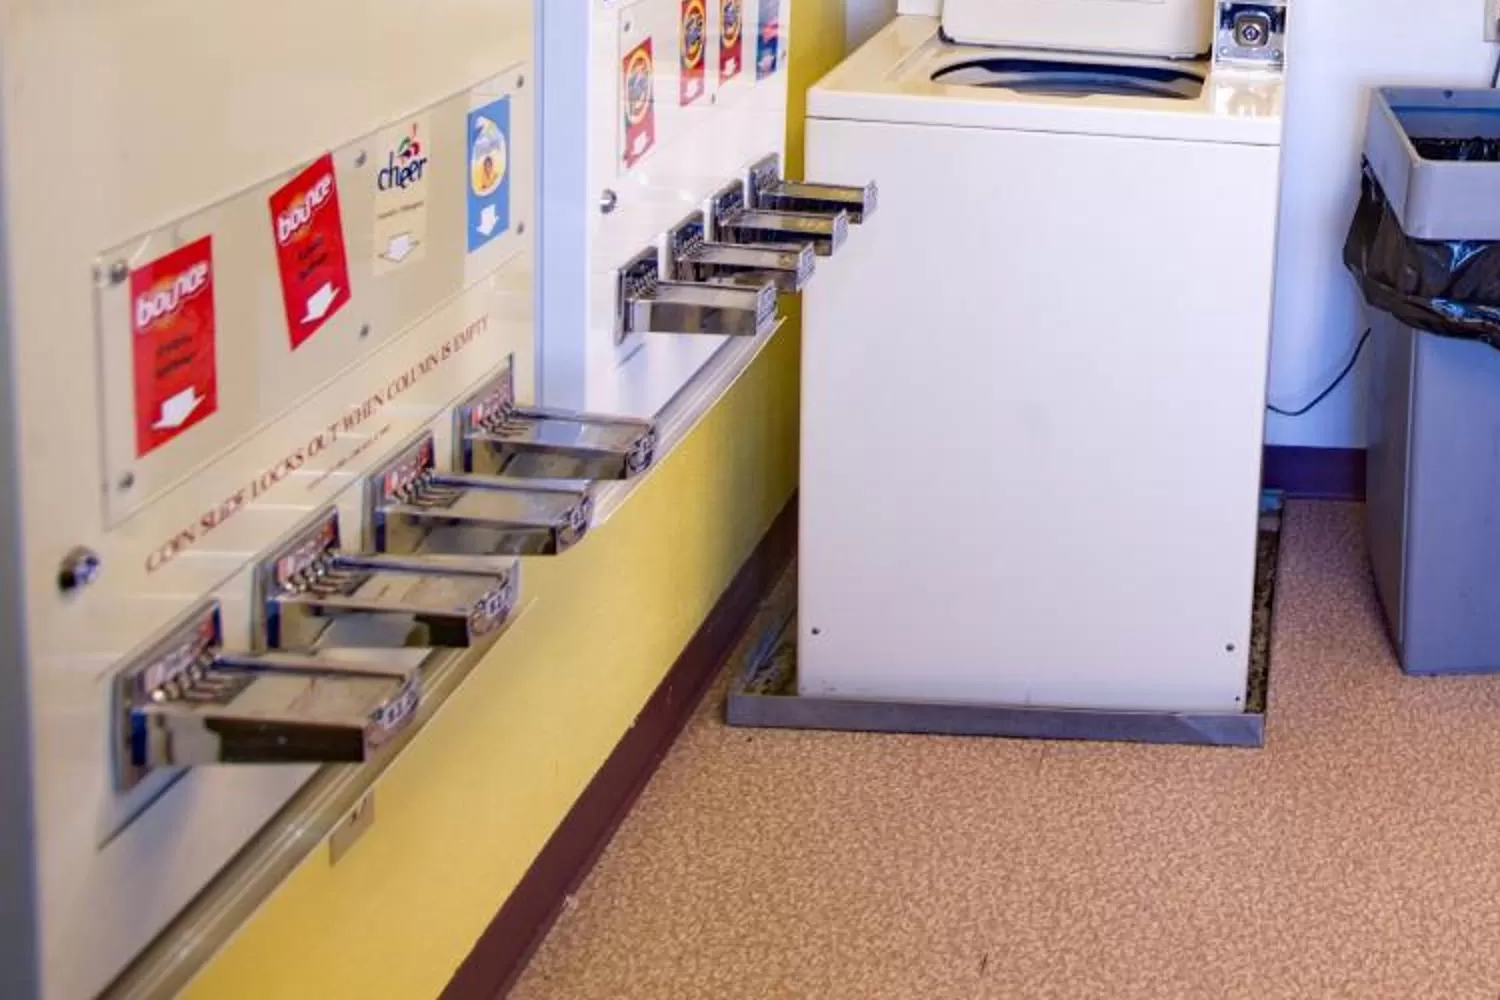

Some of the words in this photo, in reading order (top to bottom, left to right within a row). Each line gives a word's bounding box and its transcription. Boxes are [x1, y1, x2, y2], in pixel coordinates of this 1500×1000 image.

[377, 151, 427, 191] cheer
[278, 174, 332, 243] bounce
[136, 261, 208, 328] bounce
[144, 523, 196, 573] COIN
[251, 451, 305, 499] LOCKS
[308, 422, 338, 458] OUT
[338, 391, 386, 434] WHEN
[386, 355, 440, 400] COLUMN
[453, 314, 489, 352] EMPTY
